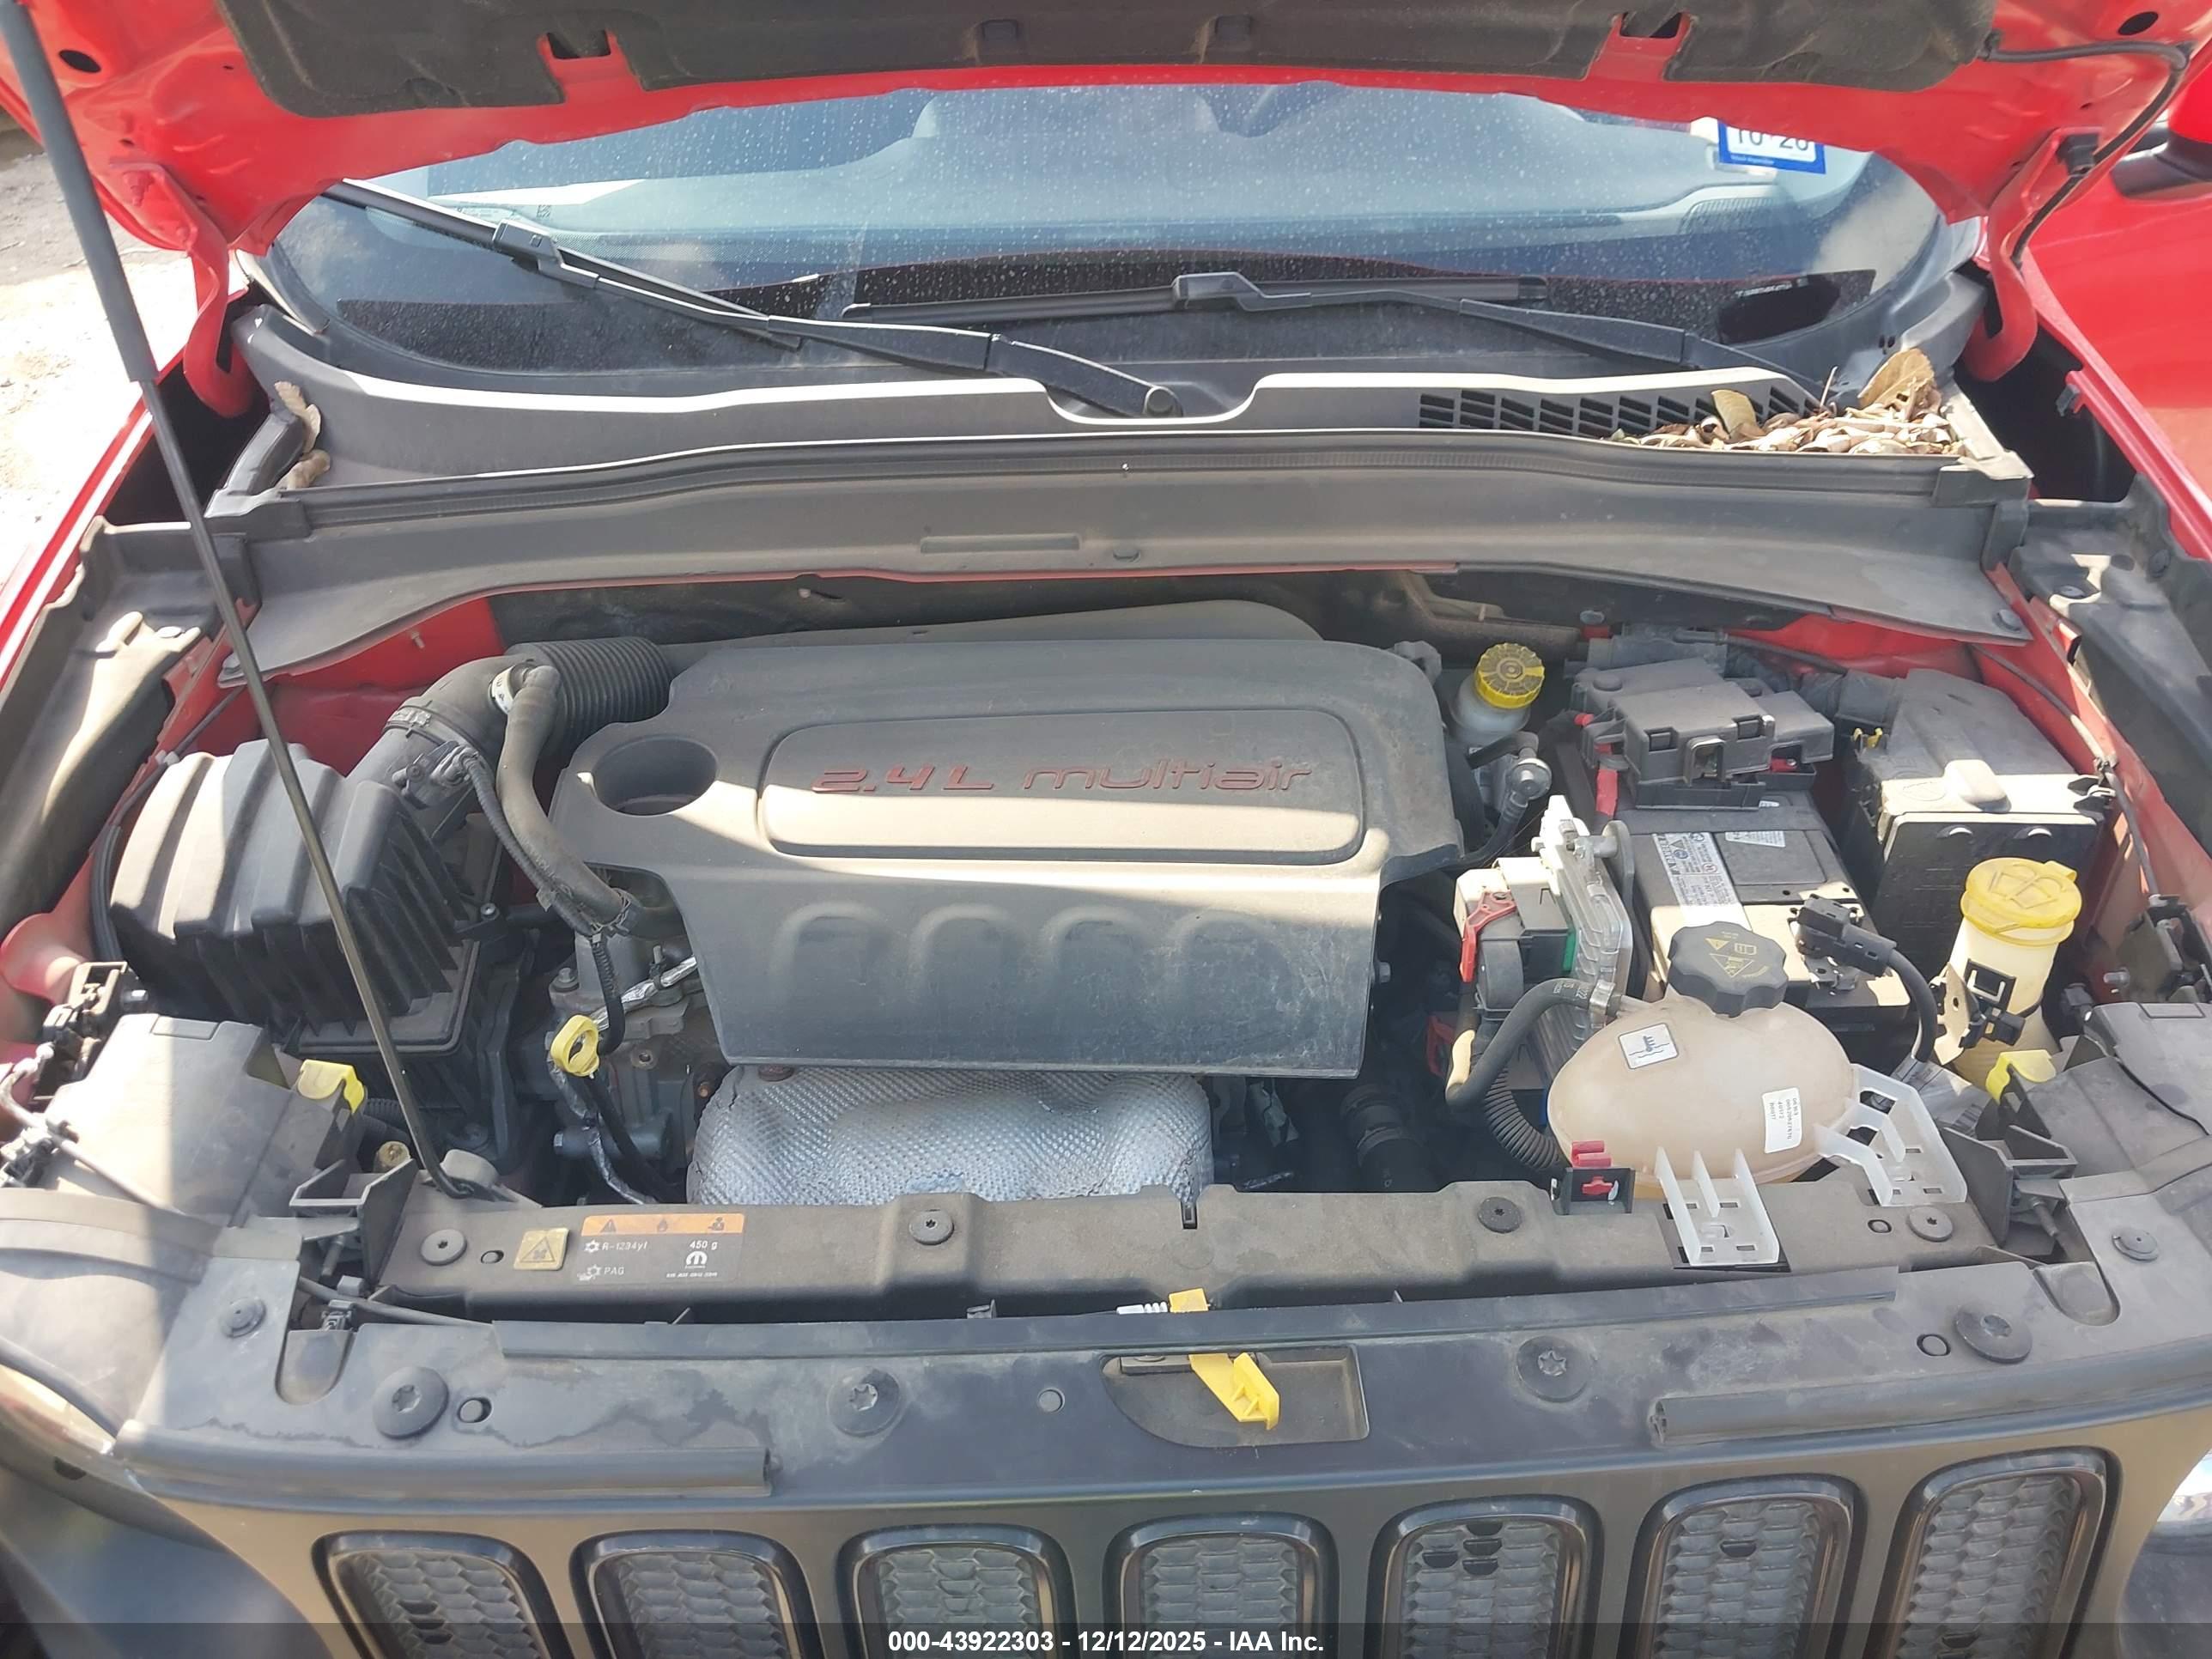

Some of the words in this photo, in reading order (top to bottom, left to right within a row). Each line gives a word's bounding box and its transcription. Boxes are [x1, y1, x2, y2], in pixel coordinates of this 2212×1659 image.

[1024, 759, 1312, 790] multiair
[689, 1240, 708, 1249] 450
[604, 1266, 625, 1276] PAG
